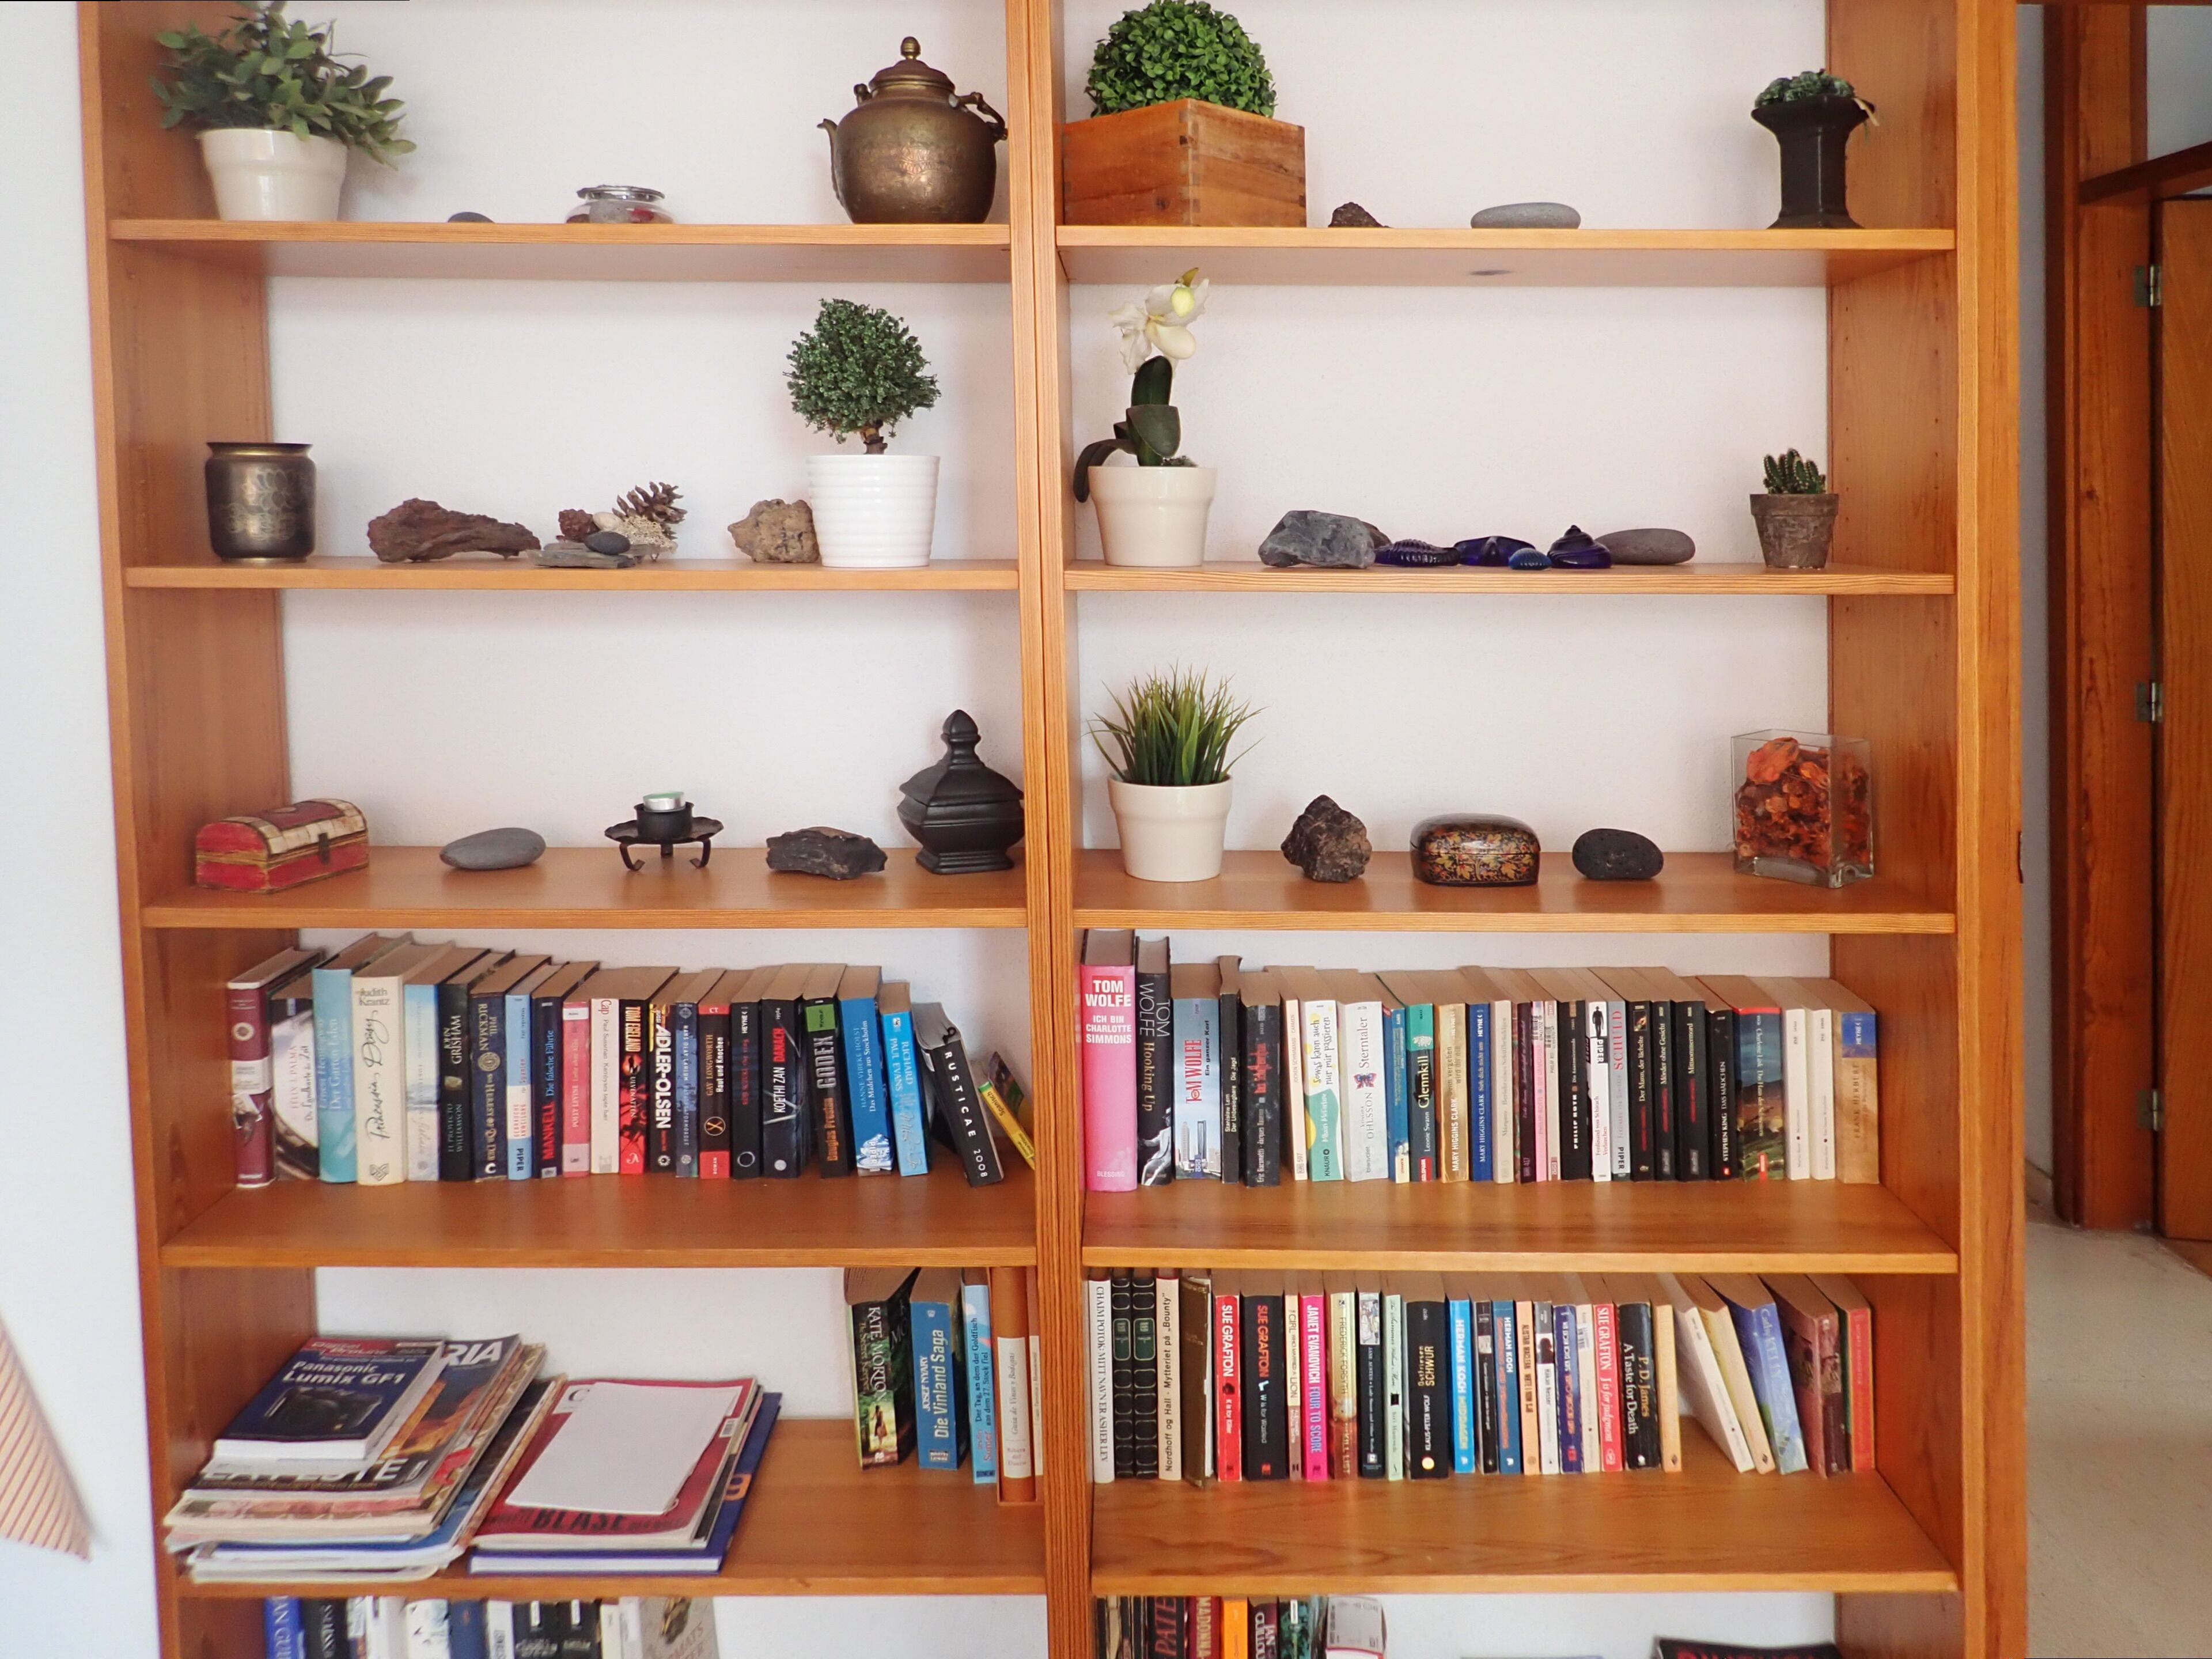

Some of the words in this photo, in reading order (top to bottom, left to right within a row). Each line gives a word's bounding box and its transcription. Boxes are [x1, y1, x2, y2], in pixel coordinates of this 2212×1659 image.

[358, 987, 388, 997] Judith
[1092, 980, 1123, 993] TOM
[358, 997, 391, 1006] Krantz
[1085, 994, 1131, 1007] WOLFE
[1138, 983, 1155, 1036] WOLFE
[477, 1003, 490, 1051] RICKMAN
[488, 1016, 498, 1036] PHIL
[625, 1006, 641, 1022] TOM
[1092, 1015, 1107, 1023] ICH
[1109, 1015, 1124, 1023] BIN
[1156, 999, 1171, 1037] TOM
[443, 1027, 451, 1050] JOHN
[449, 1015, 463, 1065] GRISHAM
[625, 1022, 641, 1052] EGELAND
[861, 1020, 871, 1055] Stockholm
[1086, 1024, 1132, 1033] CHARLOTTE
[1086, 1034, 1132, 1044] SIMMONS
[1309, 1020, 1320, 1037] auch
[1321, 1017, 1334, 1051] passieren
[1611, 1010, 1624, 1070] SCHULD
[1658, 1023, 1666, 1046] Gesicht
[715, 1037, 724, 1063] Knochen
[772, 1028, 785, 1062] DANACH
[890, 1038, 900, 1059] PAUL
[1310, 1040, 1321, 1060] kann
[1357, 1017, 1370, 1069] Sterntaler
[1597, 1039, 1605, 1062] PIPER
[1687, 1023, 1695, 1074] Mittsommermord
[545, 1056, 555, 1081] falsche
[705, 1035, 713, 1079] LONGWORTH
[902, 1041, 914, 1085] RICHARD
[1141, 1041, 1155, 1091] Hooking
[1184, 1040, 1203, 1078] WOLFE
[1323, 1055, 1332, 1068] mir
[518, 1059, 527, 1084] Spanien
[655, 1024, 672, 1128] ADLER-OLSEN
[715, 1065, 724, 1077] und
[773, 1067, 786, 1084] ZAN
[865, 1068, 876, 1098] Mädchen
[892, 1063, 903, 1092] EVANS
[1324, 1071, 1334, 1085] nur
[1416, 1055, 1430, 1108] Glennkill
[1659, 1063, 1667, 1085] Mörder
[546, 1082, 555, 1097] Die
[706, 1083, 714, 1096] GAY
[715, 1078, 724, 1093] Haut
[774, 1085, 786, 1113] KOETHI
[868, 1099, 877, 1112] Das
[986, 1090, 1006, 1116] Spanisch
[1141, 1096, 1155, 1111] Up
[1450, 1098, 1459, 1120] CLARK
[823, 1097, 836, 1128] Preston
[944, 1051, 976, 1137] RUSTICAE
[973, 1149, 988, 1177] 2008
[1363, 1092, 1374, 1139] OHLSSON
[455, 1103, 464, 1153] WILLIAMSON
[542, 1101, 556, 1161] MANKELL
[1451, 1122, 1459, 1150] HIGGINS
[825, 1130, 839, 1161] Douglas
[516, 1147, 525, 1172] PIPER
[1323, 1155, 1331, 1177] KNAUR
[1452, 1152, 1460, 1171] MARY
[1096, 1286, 1104, 1317] CHAIM
[1222, 1305, 1233, 1324] SUE
[867, 1306, 882, 1340] KATE
[1257, 1305, 1268, 1325] SUE
[1306, 1305, 1320, 1333] JANET
[1597, 1307, 1610, 1325] SUE
[930, 1329, 948, 1362] Saga
[1097, 1319, 1105, 1351] POTOK:
[1162, 1336, 1172, 1346] på
[1339, 1317, 1348, 1357] FREDERICK
[1455, 1319, 1467, 1363] HERMAN
[1503, 1317, 1513, 1350] HERMAN
[1222, 1325, 1234, 1377] GRAFTON
[1257, 1325, 1270, 1377] GRAFTON
[1307, 1334, 1320, 1383] EVANOVICH
[1599, 1326, 1612, 1370] GRAFTON
[1623, 1343, 1634, 1353] A
[292, 1361, 379, 1373] Panasonic
[919, 1354, 929, 1383] NYARY
[1097, 1352, 1106, 1376] MITT
[1163, 1350, 1172, 1389] Mytteriet
[1424, 1346, 1435, 1387] SCHWUR
[1505, 1351, 1514, 1373] KOCH
[1624, 1353, 1635, 1382] Taste
[1638, 1356, 1650, 1368] P.
[282, 1370, 357, 1384] Lumix
[361, 1373, 407, 1384] GF1
[1099, 1377, 1107, 1401] NAVN
[1340, 1359, 1349, 1394] FORSYTH
[1457, 1365, 1467, 1393] KOCH
[1639, 1370, 1650, 1382] D.
[921, 1385, 931, 1412] JOSEF
[931, 1366, 948, 1415] Vinland
[1309, 1386, 1321, 1409] FOUR
[1600, 1390, 1612, 1403] for
[1626, 1384, 1637, 1399] for
[1638, 1385, 1651, 1417] James
[1099, 1402, 1107, 1414] ER
[1310, 1411, 1322, 1423] TO
[1627, 1401, 1638, 1435] Death
[934, 1418, 949, 1438] Die
[1099, 1414, 1108, 1444] ASHER
[1166, 1419, 1173, 1430] og
[1601, 1403, 1613, 1442] judgment
[1165, 1433, 1173, 1471] Nordhoff
[1310, 1425, 1323, 1453] SCORE
[1100, 1445, 1108, 1462] LEV
